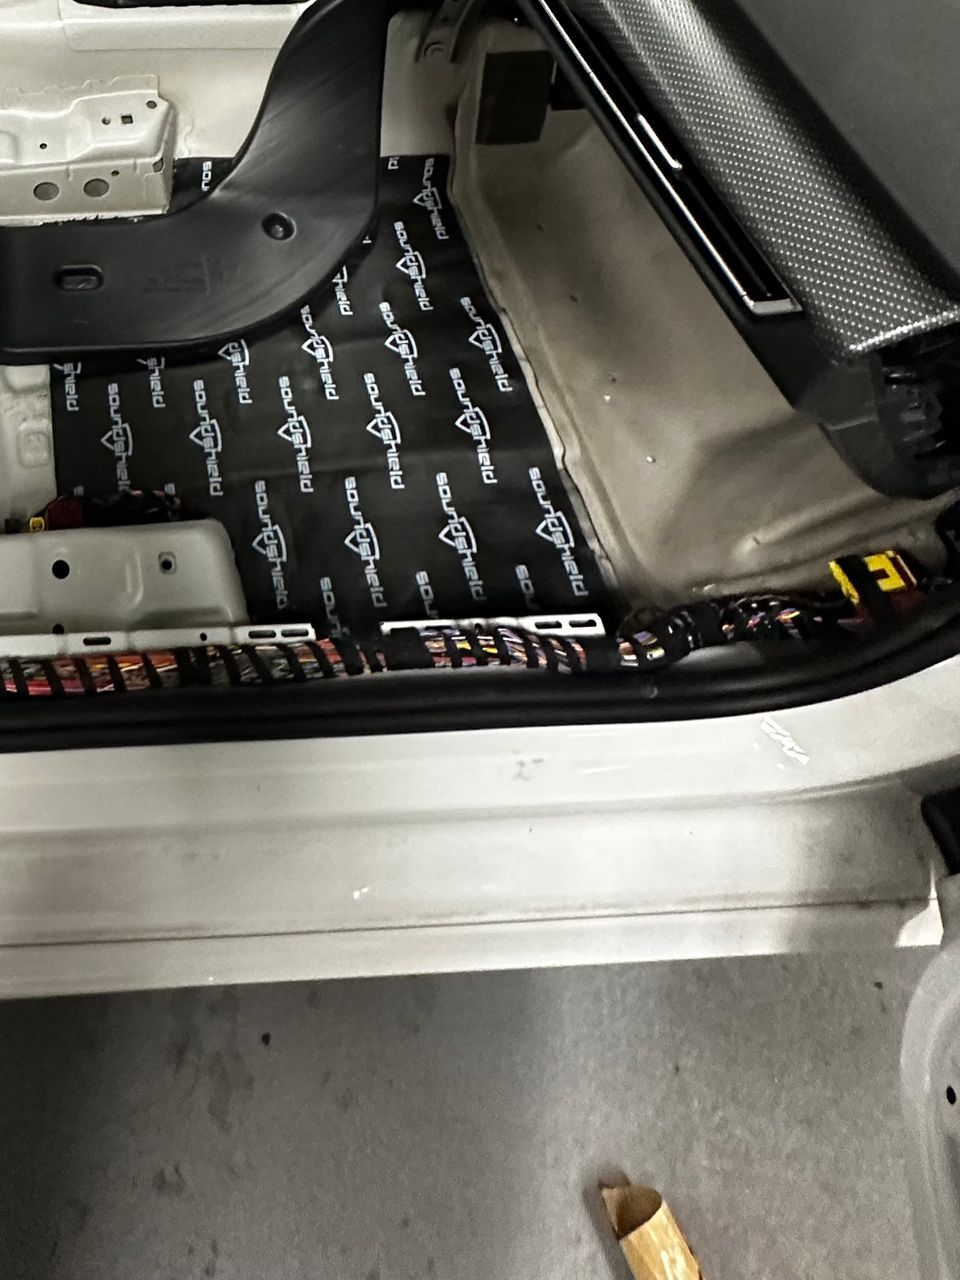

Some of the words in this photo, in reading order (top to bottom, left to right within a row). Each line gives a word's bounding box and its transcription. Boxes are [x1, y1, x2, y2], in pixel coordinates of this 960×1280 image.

[423, 157, 449, 240] soundshield
[393, 221, 434, 311] soundshield
[379, 301, 426, 396] soundshield
[459, 296, 513, 392] soundshield
[193, 379, 224, 496] soundshield
[278, 376, 314, 492] soundshield
[363, 373, 405, 489] soundshield
[449, 367, 498, 483] soundshield
[255, 480, 288, 609] soundshield
[345, 476, 387, 607] soundshield
[436, 472, 487, 601] soundshield
[528, 467, 589, 596] soundshield
